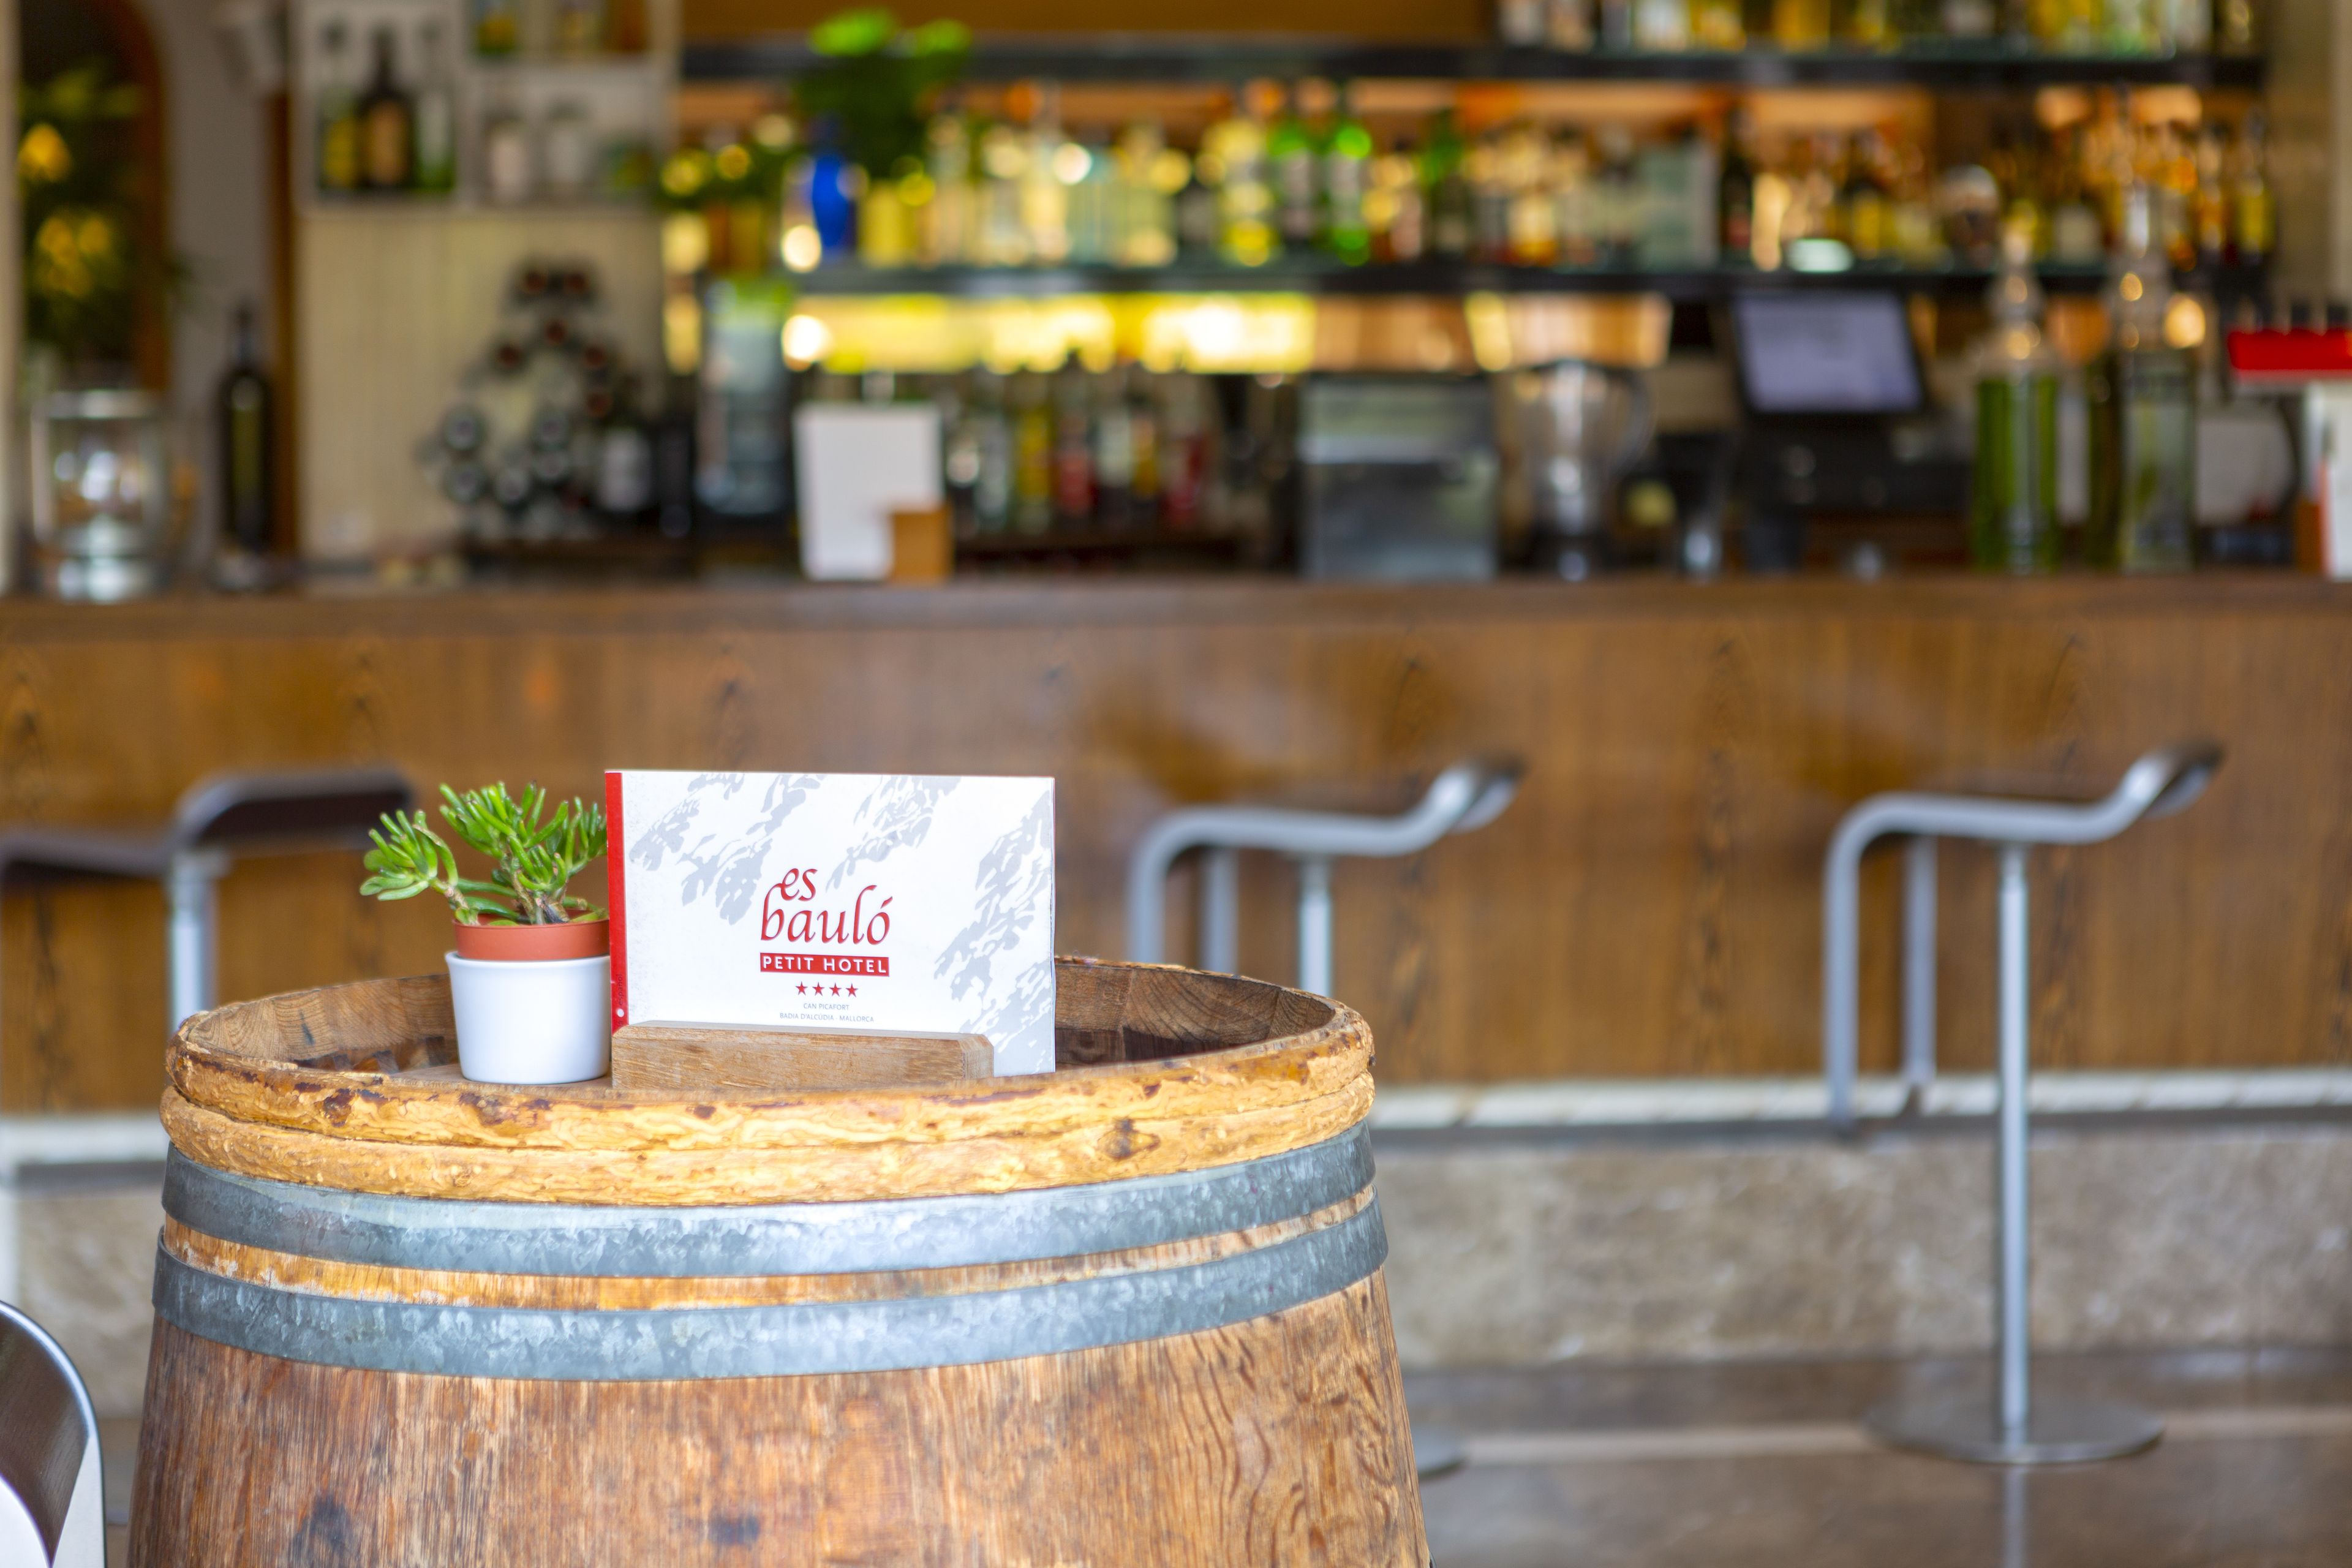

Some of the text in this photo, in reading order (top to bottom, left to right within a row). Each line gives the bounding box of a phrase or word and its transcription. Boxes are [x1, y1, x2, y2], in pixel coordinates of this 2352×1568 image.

[780, 868, 818, 902] es
[761, 883, 893, 945] bauló
[763, 956, 887, 973] PETIT HOTEL
